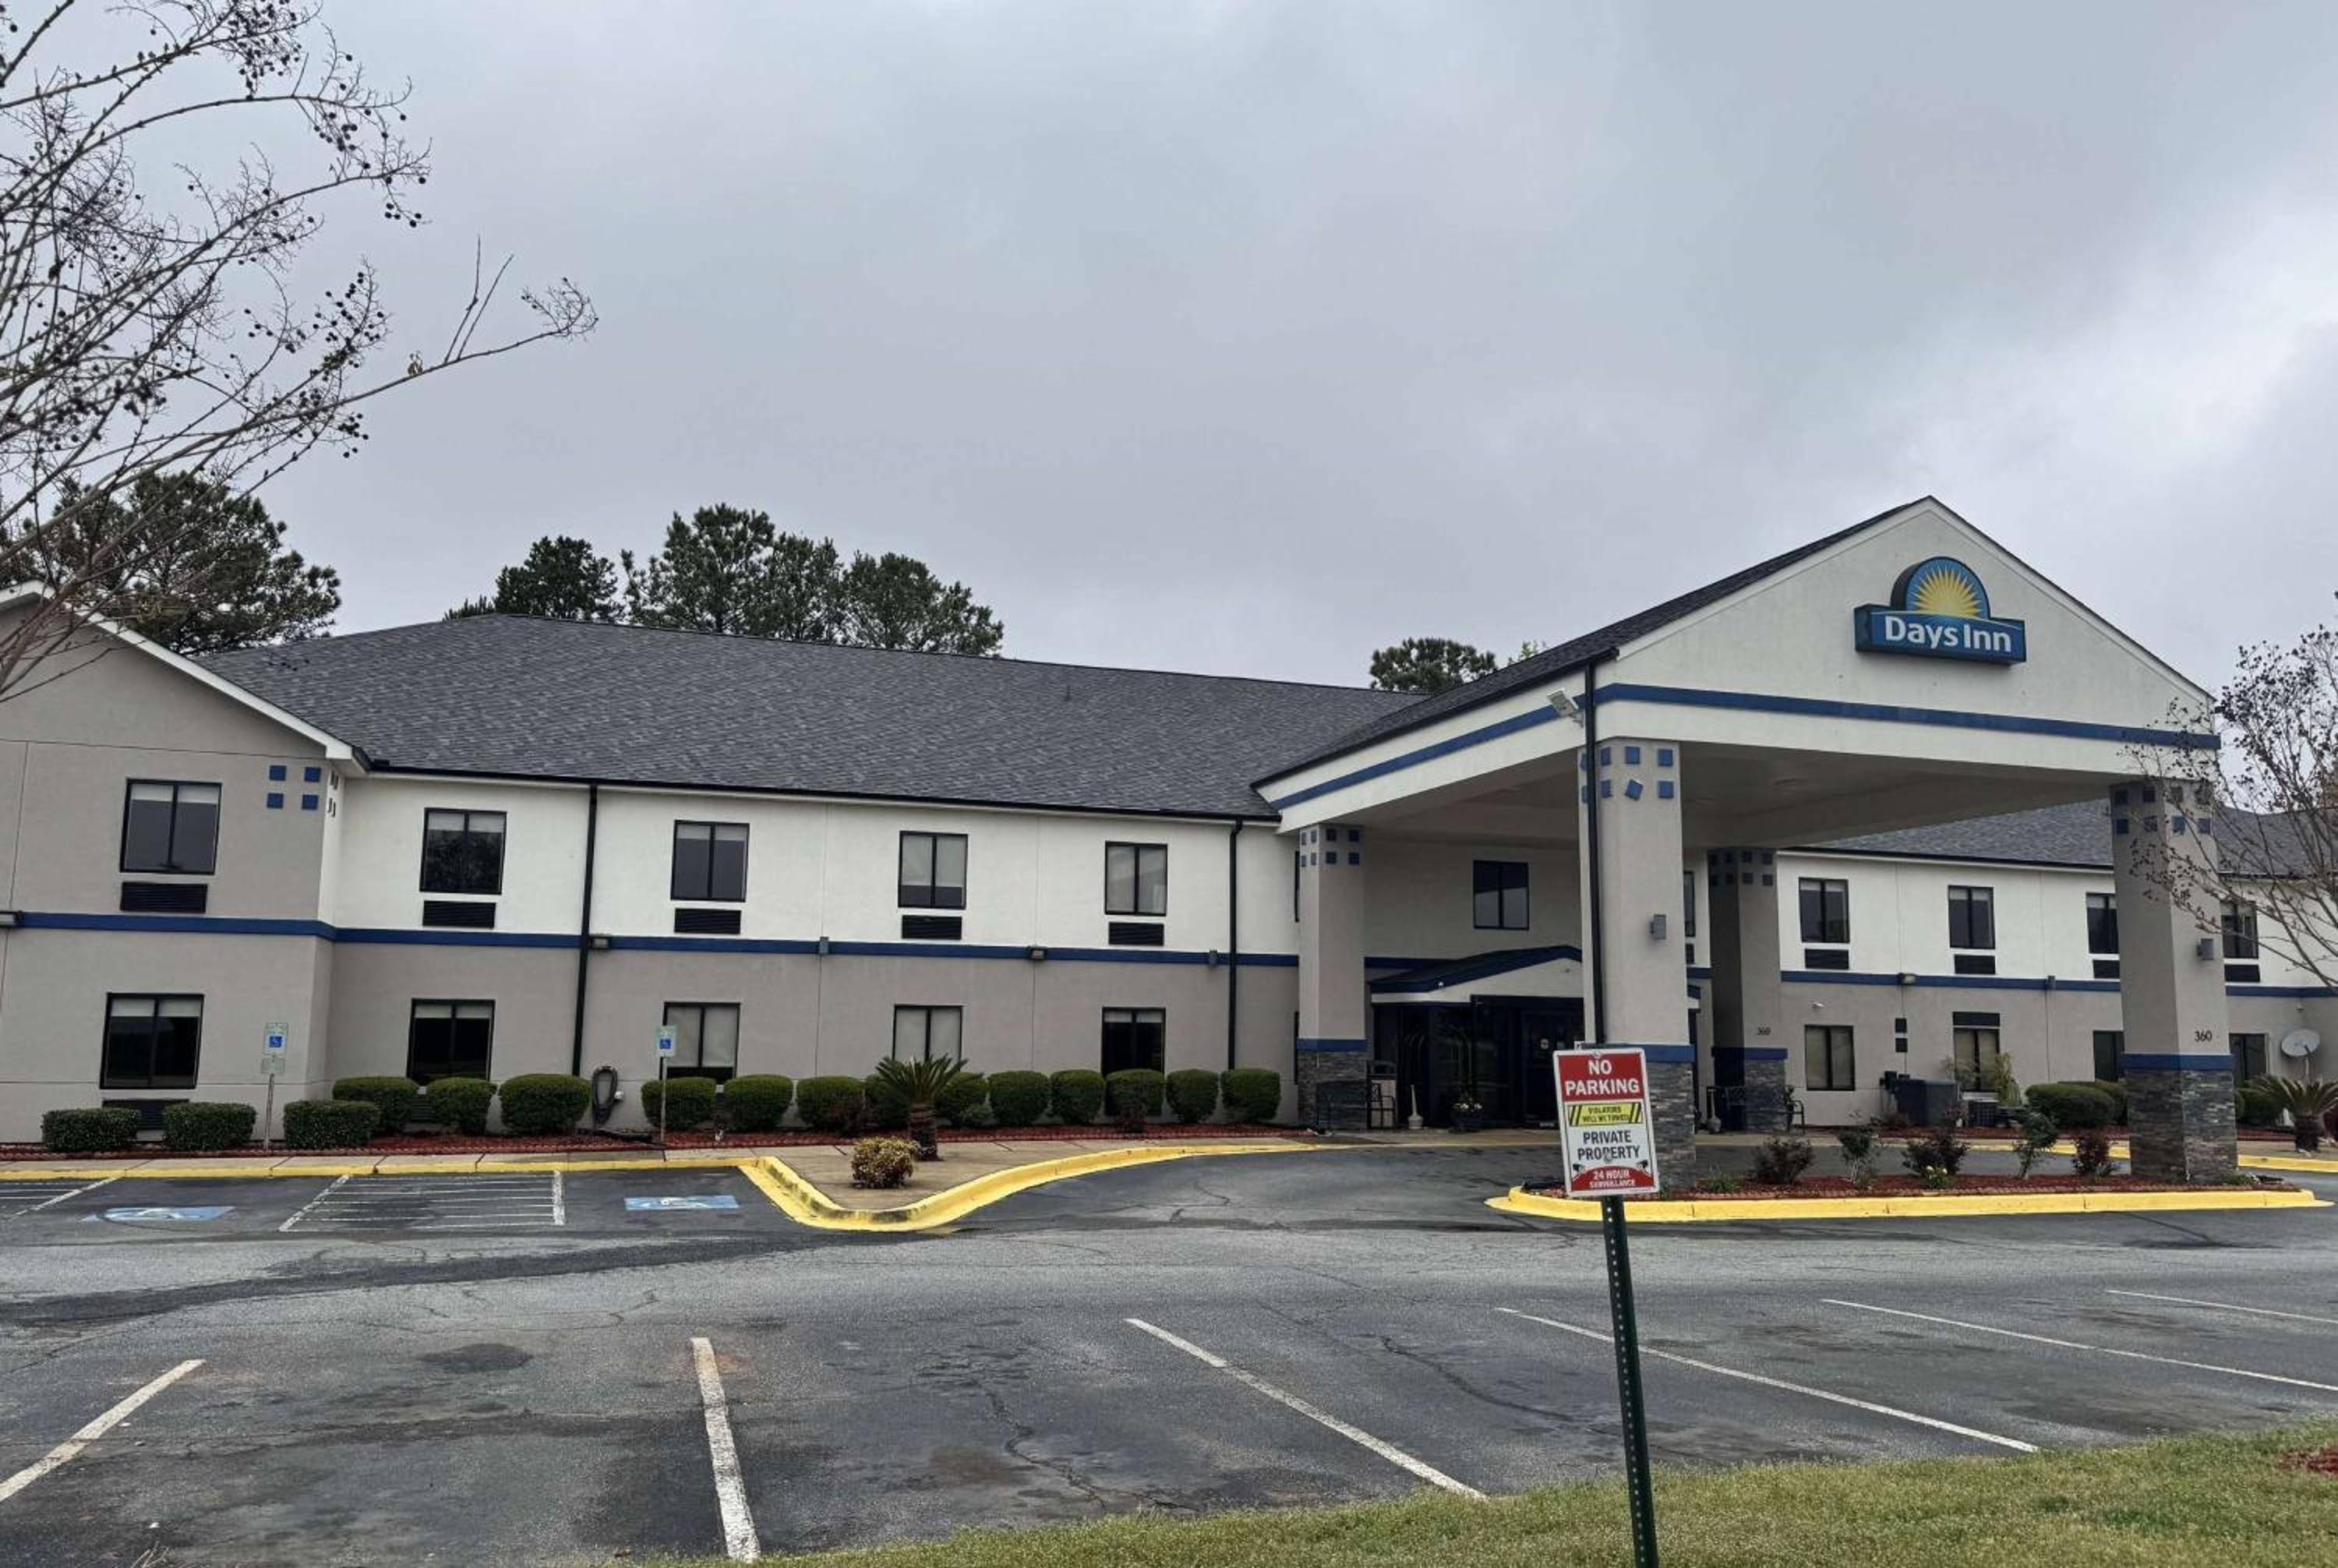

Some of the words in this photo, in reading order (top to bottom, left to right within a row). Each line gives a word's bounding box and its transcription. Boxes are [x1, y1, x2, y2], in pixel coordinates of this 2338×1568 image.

[1885, 616, 1958, 648] Days
[1963, 623, 2011, 652] Inn
[2194, 1029, 2213, 1042] 360
[1588, 1059, 1612, 1075] NO
[1565, 1079, 1640, 1097] PARKING
[1584, 1130, 1631, 1144] PRIVATE
[1577, 1145, 1640, 1160] PROPERTY
[1593, 1171, 1605, 1180] 24
[1606, 1169, 1630, 1179] HOUR
